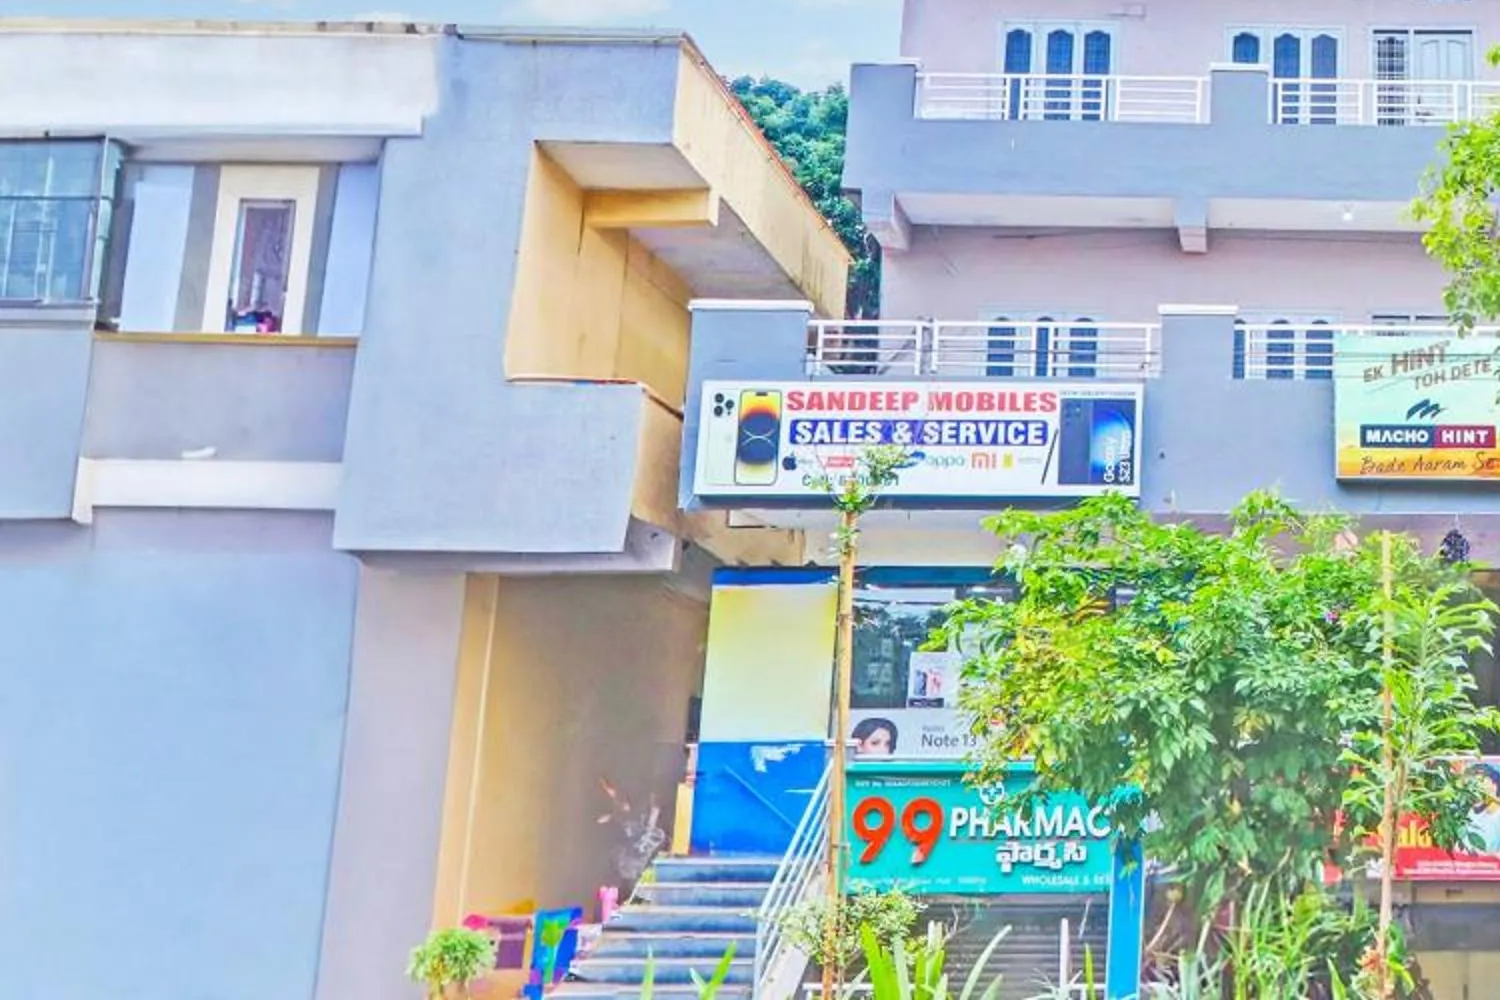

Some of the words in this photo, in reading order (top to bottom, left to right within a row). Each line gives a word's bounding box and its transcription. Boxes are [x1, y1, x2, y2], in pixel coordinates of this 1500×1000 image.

[1362, 365, 1384, 384] EK
[1390, 340, 1451, 376] HINT
[1414, 370, 1447, 390] TOH
[1450, 357, 1493, 381] DETE
[787, 391, 919, 411] SANDEEP
[927, 391, 1057, 412] MOBILES
[796, 421, 882, 443] SALES
[892, 421, 913, 443] &
[923, 421, 1045, 444] SERVICE
[1365, 429, 1429, 443] MACHO
[1441, 429, 1489, 443] HINT
[921, 733, 960, 748] Note
[852, 796, 945, 865] 99
[949, 804, 1128, 838] PHARMAC
